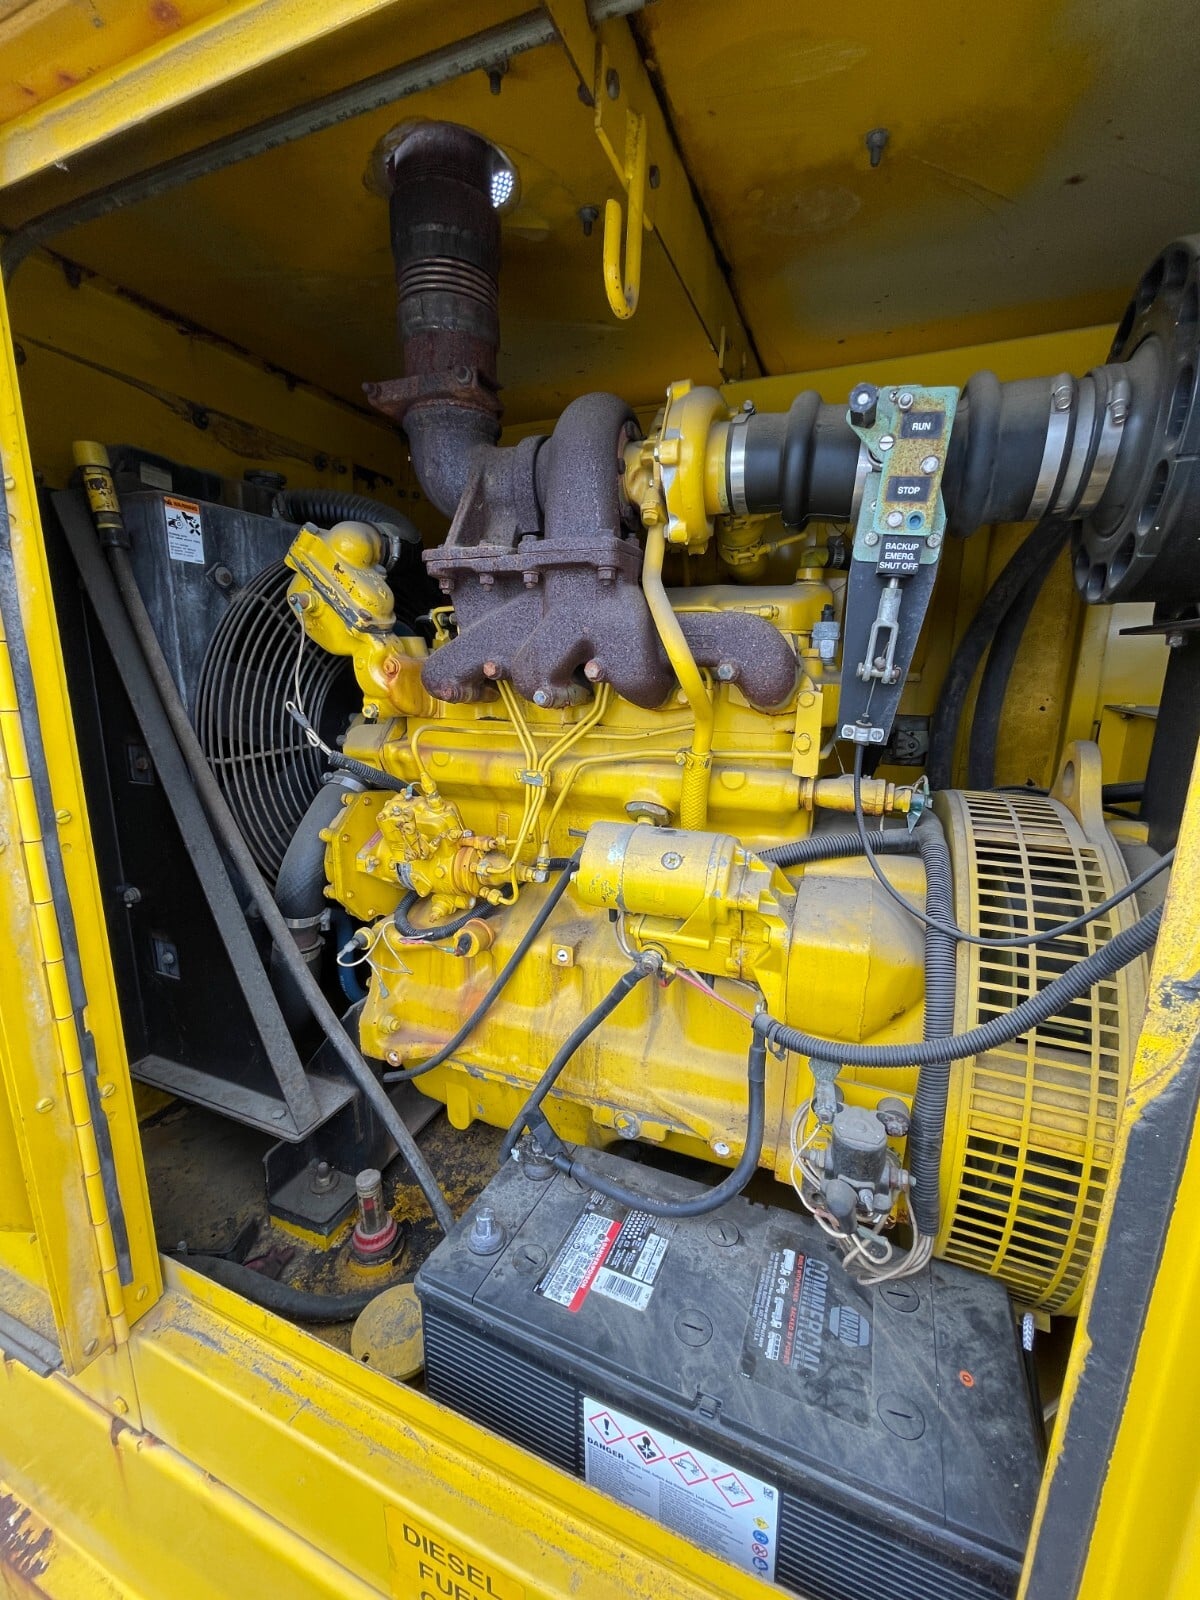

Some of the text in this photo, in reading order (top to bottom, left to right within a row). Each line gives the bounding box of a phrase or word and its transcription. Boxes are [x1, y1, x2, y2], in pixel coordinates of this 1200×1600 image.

[911, 422, 932, 431] RUN
[897, 486, 921, 495] STOP
[885, 542, 920, 551] BACKUP
[884, 552, 916, 561] EMERG.
[879, 561, 919, 571] SHUT OFF
[792, 1257, 829, 1372] COMMERCIAL
[840, 1311, 859, 1343] NAPA
[587, 1436, 625, 1460] DANGER
[403, 1523, 503, 1600] DIESEL
[418, 1560, 478, 1600] FUE
